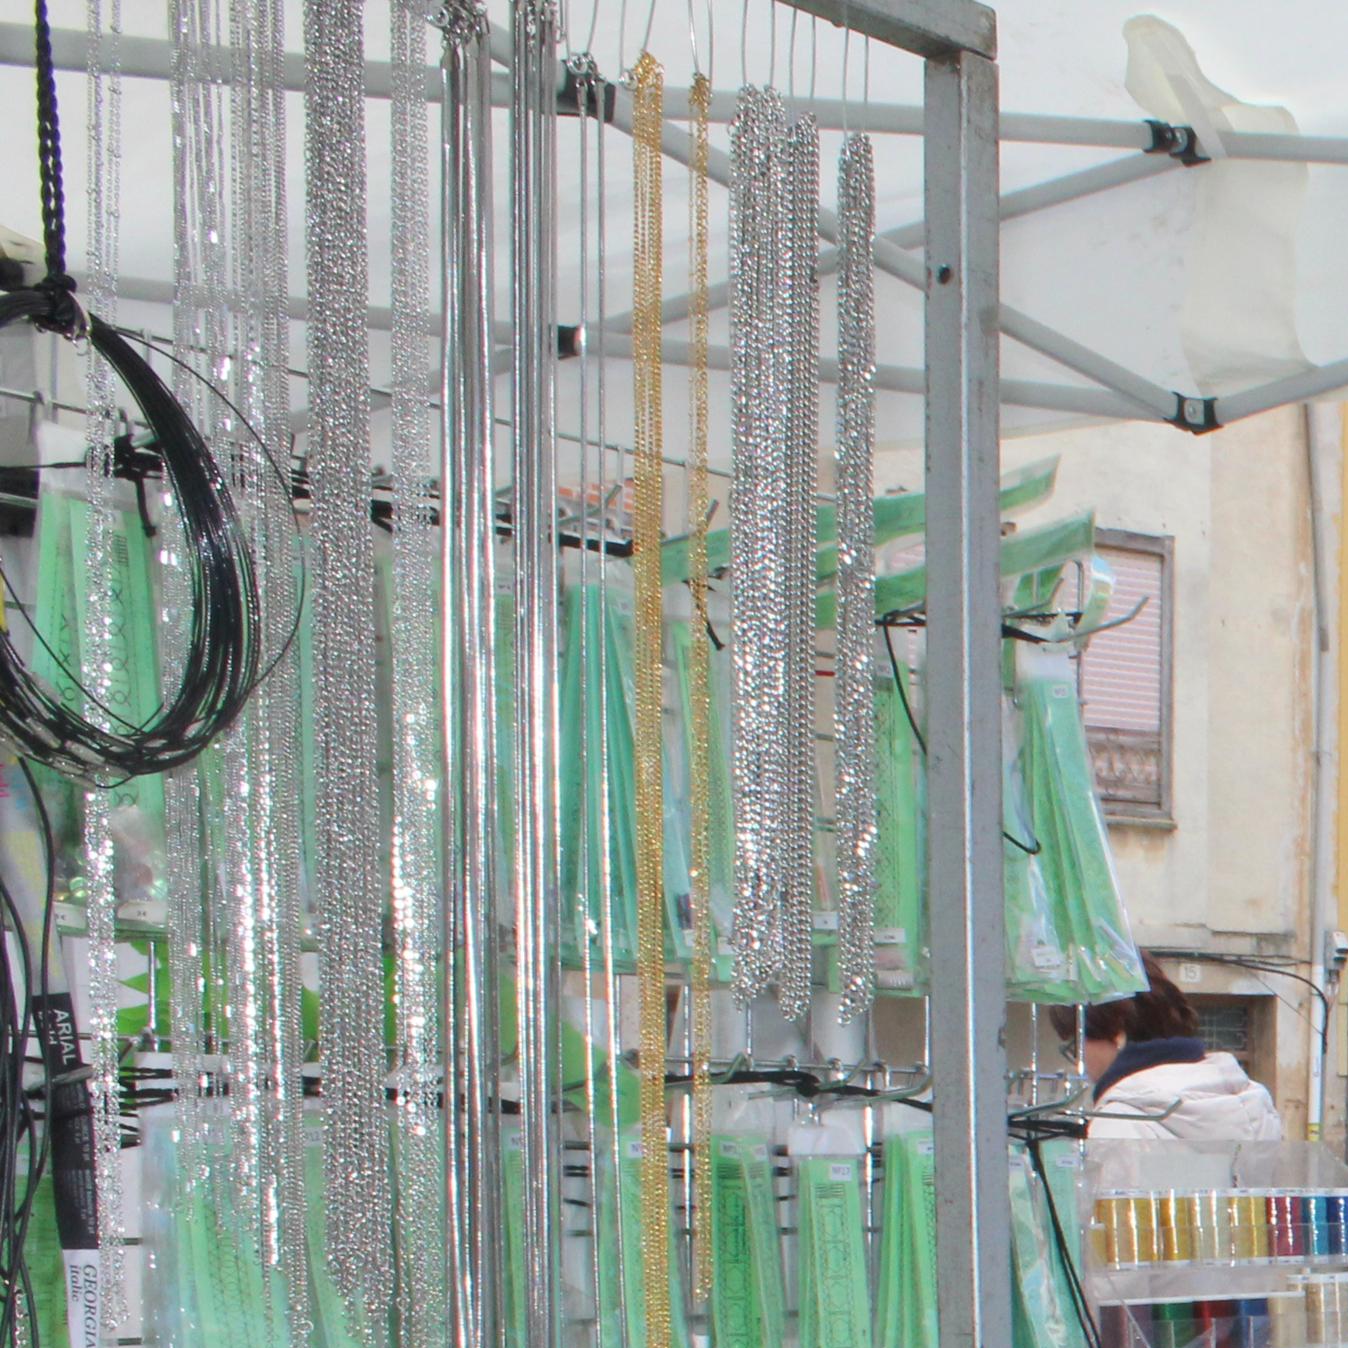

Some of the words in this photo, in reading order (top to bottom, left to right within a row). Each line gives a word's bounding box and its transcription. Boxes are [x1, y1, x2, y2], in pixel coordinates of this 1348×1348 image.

[53, 1008, 77, 1066] ARIAL
[69, 1264, 80, 1302] italic
[83, 1264, 98, 1348] GEORGIA
